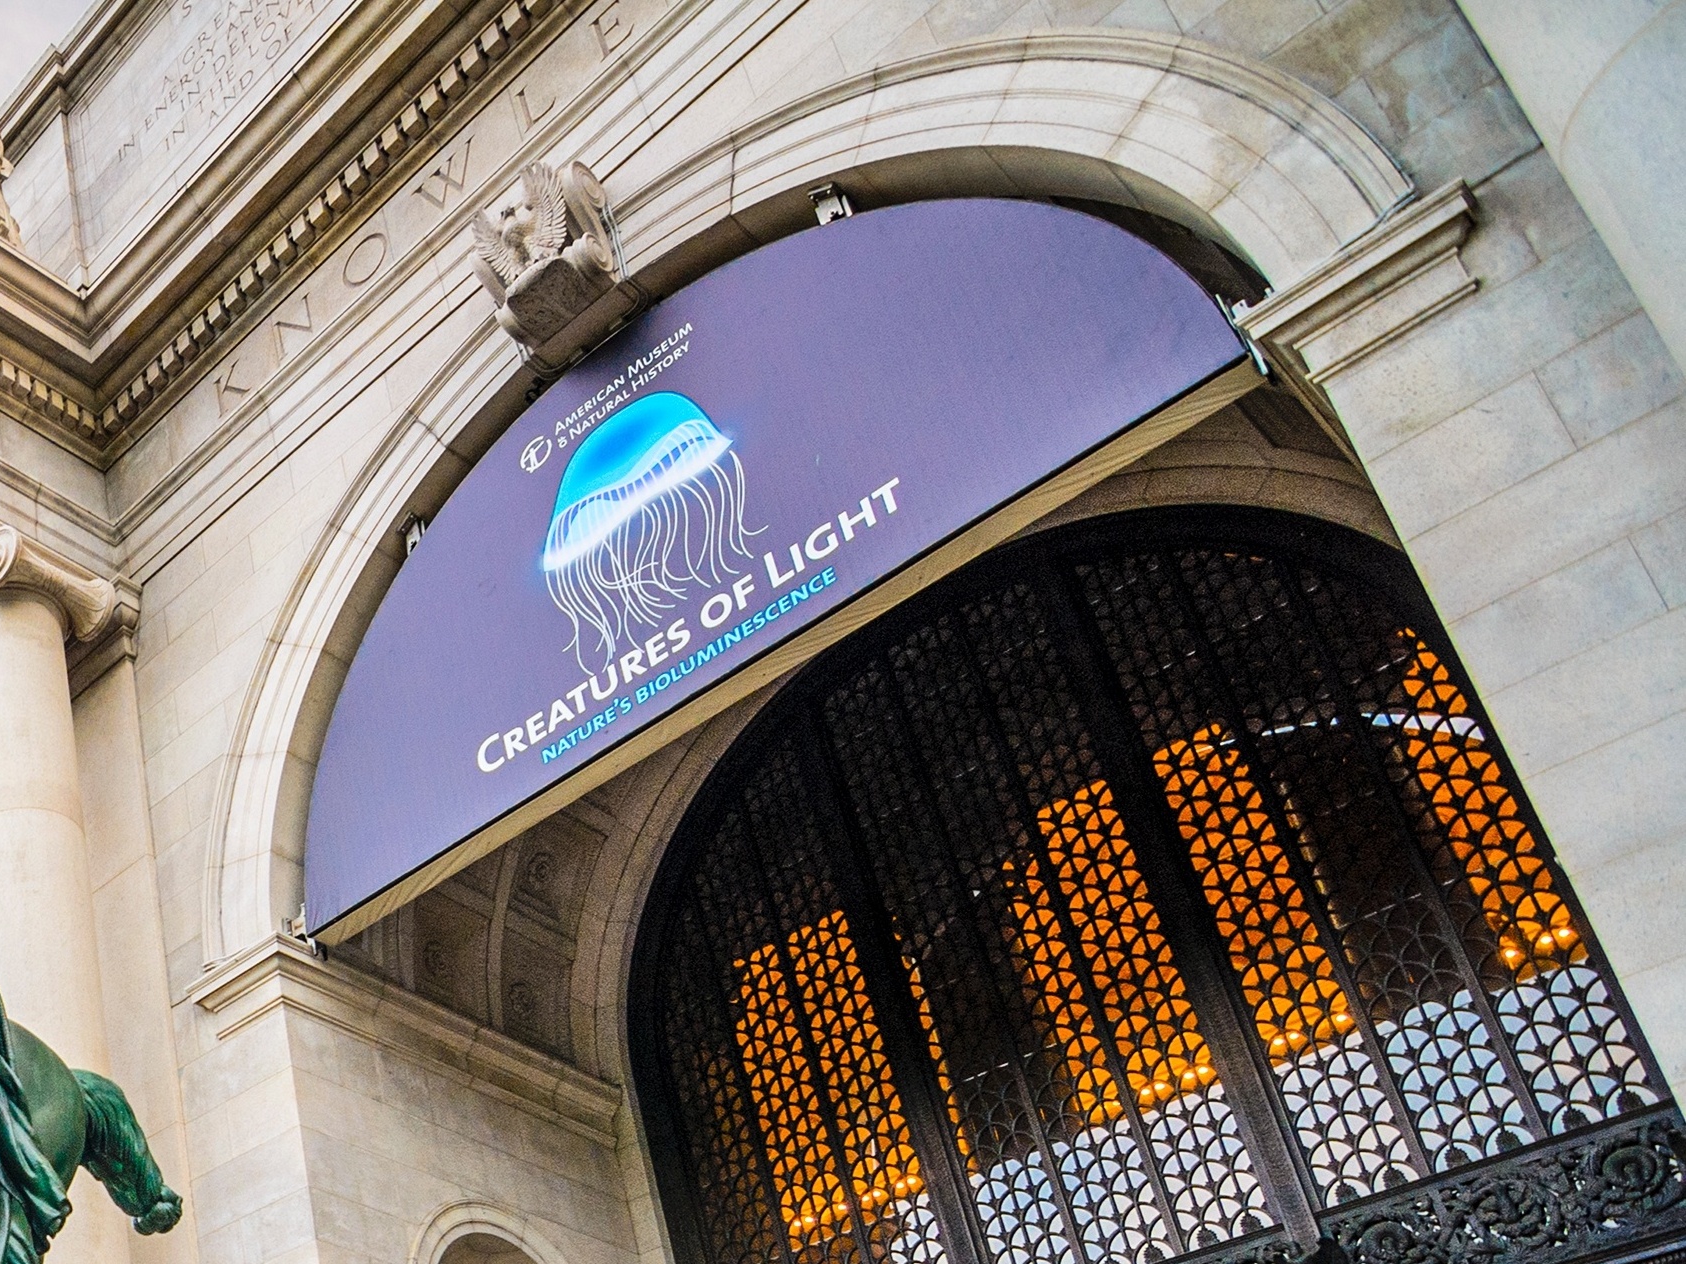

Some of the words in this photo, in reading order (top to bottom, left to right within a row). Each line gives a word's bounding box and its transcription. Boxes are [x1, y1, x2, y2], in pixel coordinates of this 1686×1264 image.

[118, 134, 137, 162] IN
[144, 39, 218, 131] ENERGY
[165, 119, 186, 151] IN
[195, 62, 237, 115] THE
[180, 81, 202, 112] IN
[207, 68, 255, 128] AND
[265, 21, 294, 61] OF
[554, 374, 626, 436] AMERICAN
[627, 322, 694, 379] MUSEUM
[569, 389, 631, 440] NATURAL
[631, 340, 691, 392] HISTORY
[476, 617, 692, 773] CREATURES
[700, 573, 757, 629] OF
[763, 477, 901, 590] LIGHT
[540, 699, 633, 765] NATURE'S
[635, 566, 838, 706] BIOLUMINESCENCE
